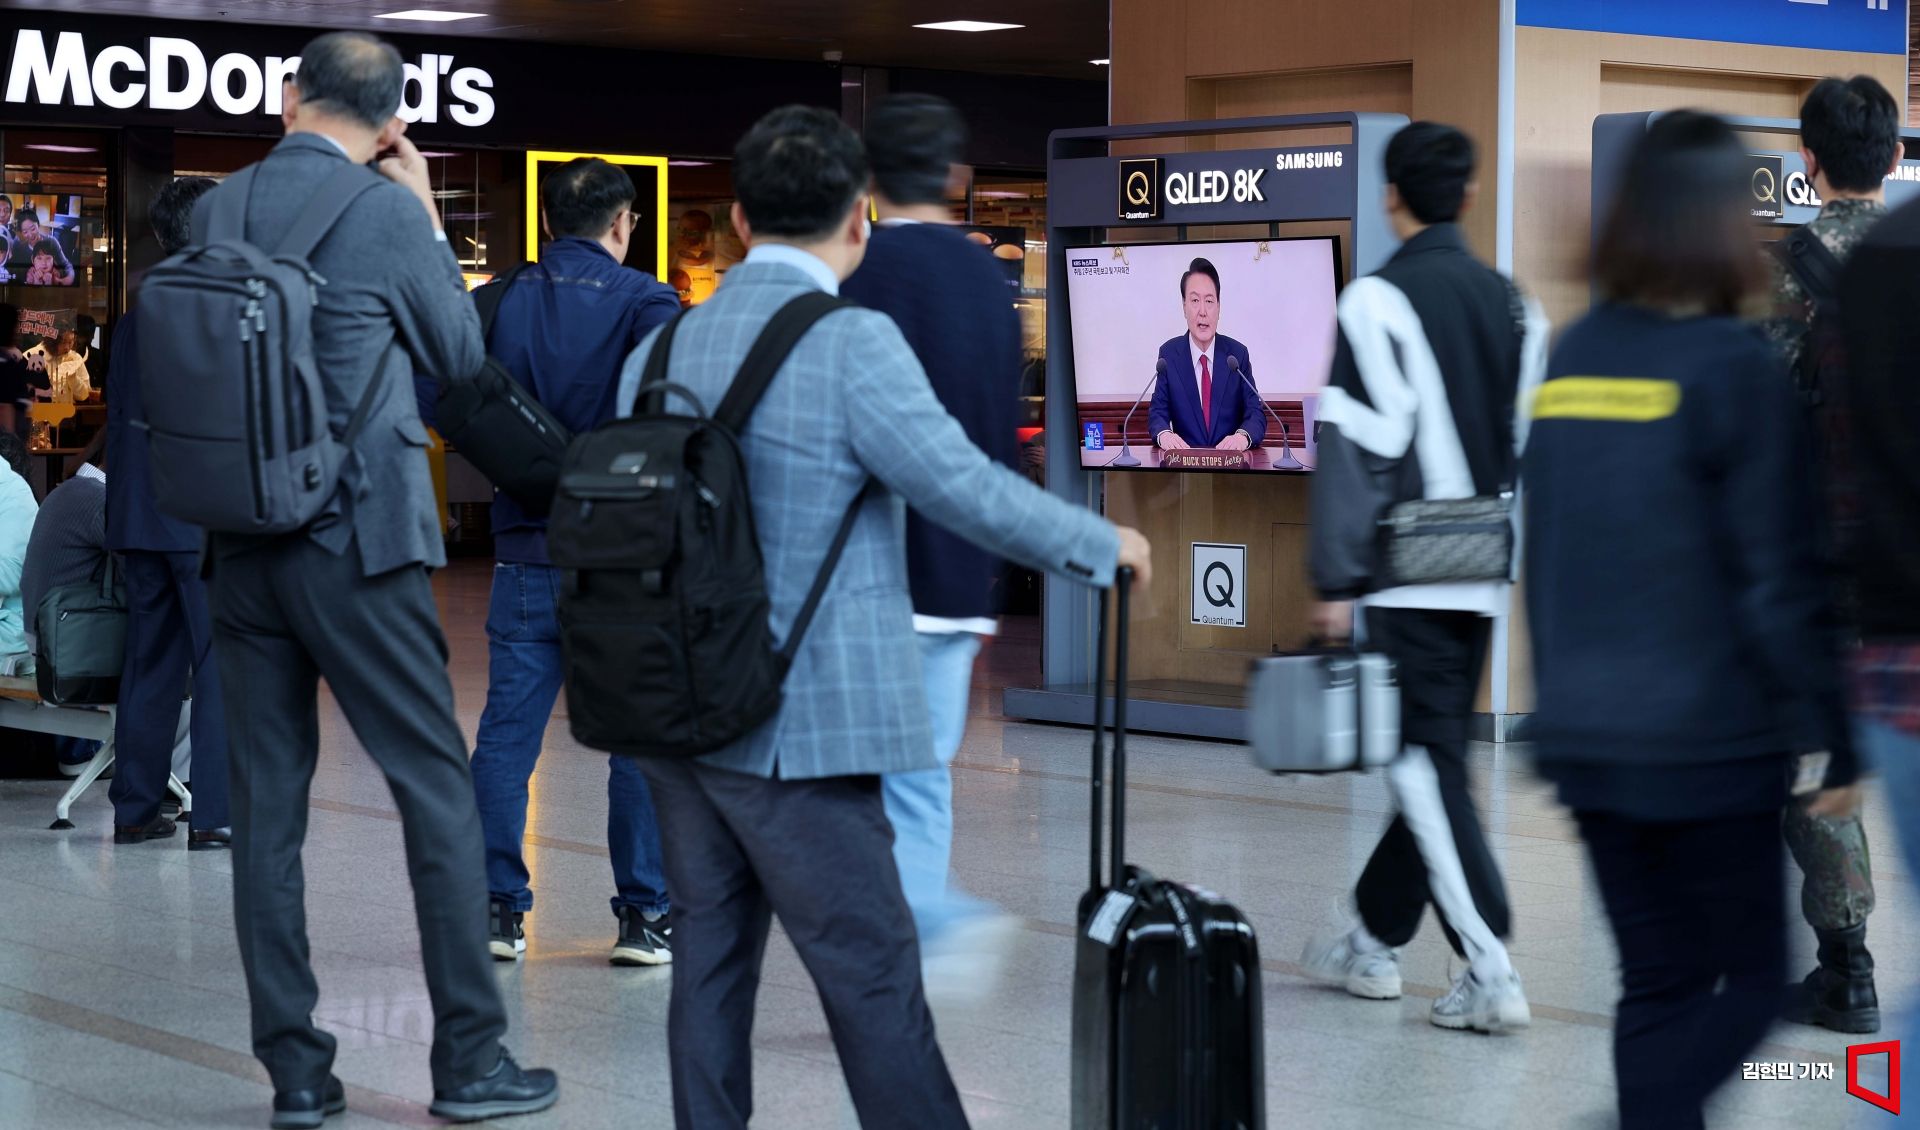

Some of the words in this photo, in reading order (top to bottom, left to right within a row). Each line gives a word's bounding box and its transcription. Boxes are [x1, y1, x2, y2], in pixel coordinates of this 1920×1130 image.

[6, 29, 495, 127] McDond's
[1276, 151, 1343, 170] SAMSUNG
[1127, 171, 1150, 205] Q
[1165, 170, 1229, 205] QLED
[1233, 168, 1265, 203] 8K
[1752, 167, 1777, 203] Q
[1786, 171, 1822, 206] QL
[1751, 209, 1776, 217] Quantum
[18, 309, 55, 327] 날드에서
[1182, 456, 1200, 467] BUCK
[1201, 456, 1222, 467] STOPS
[1203, 561, 1235, 608] Q
[1202, 615, 1235, 626] Quantum
